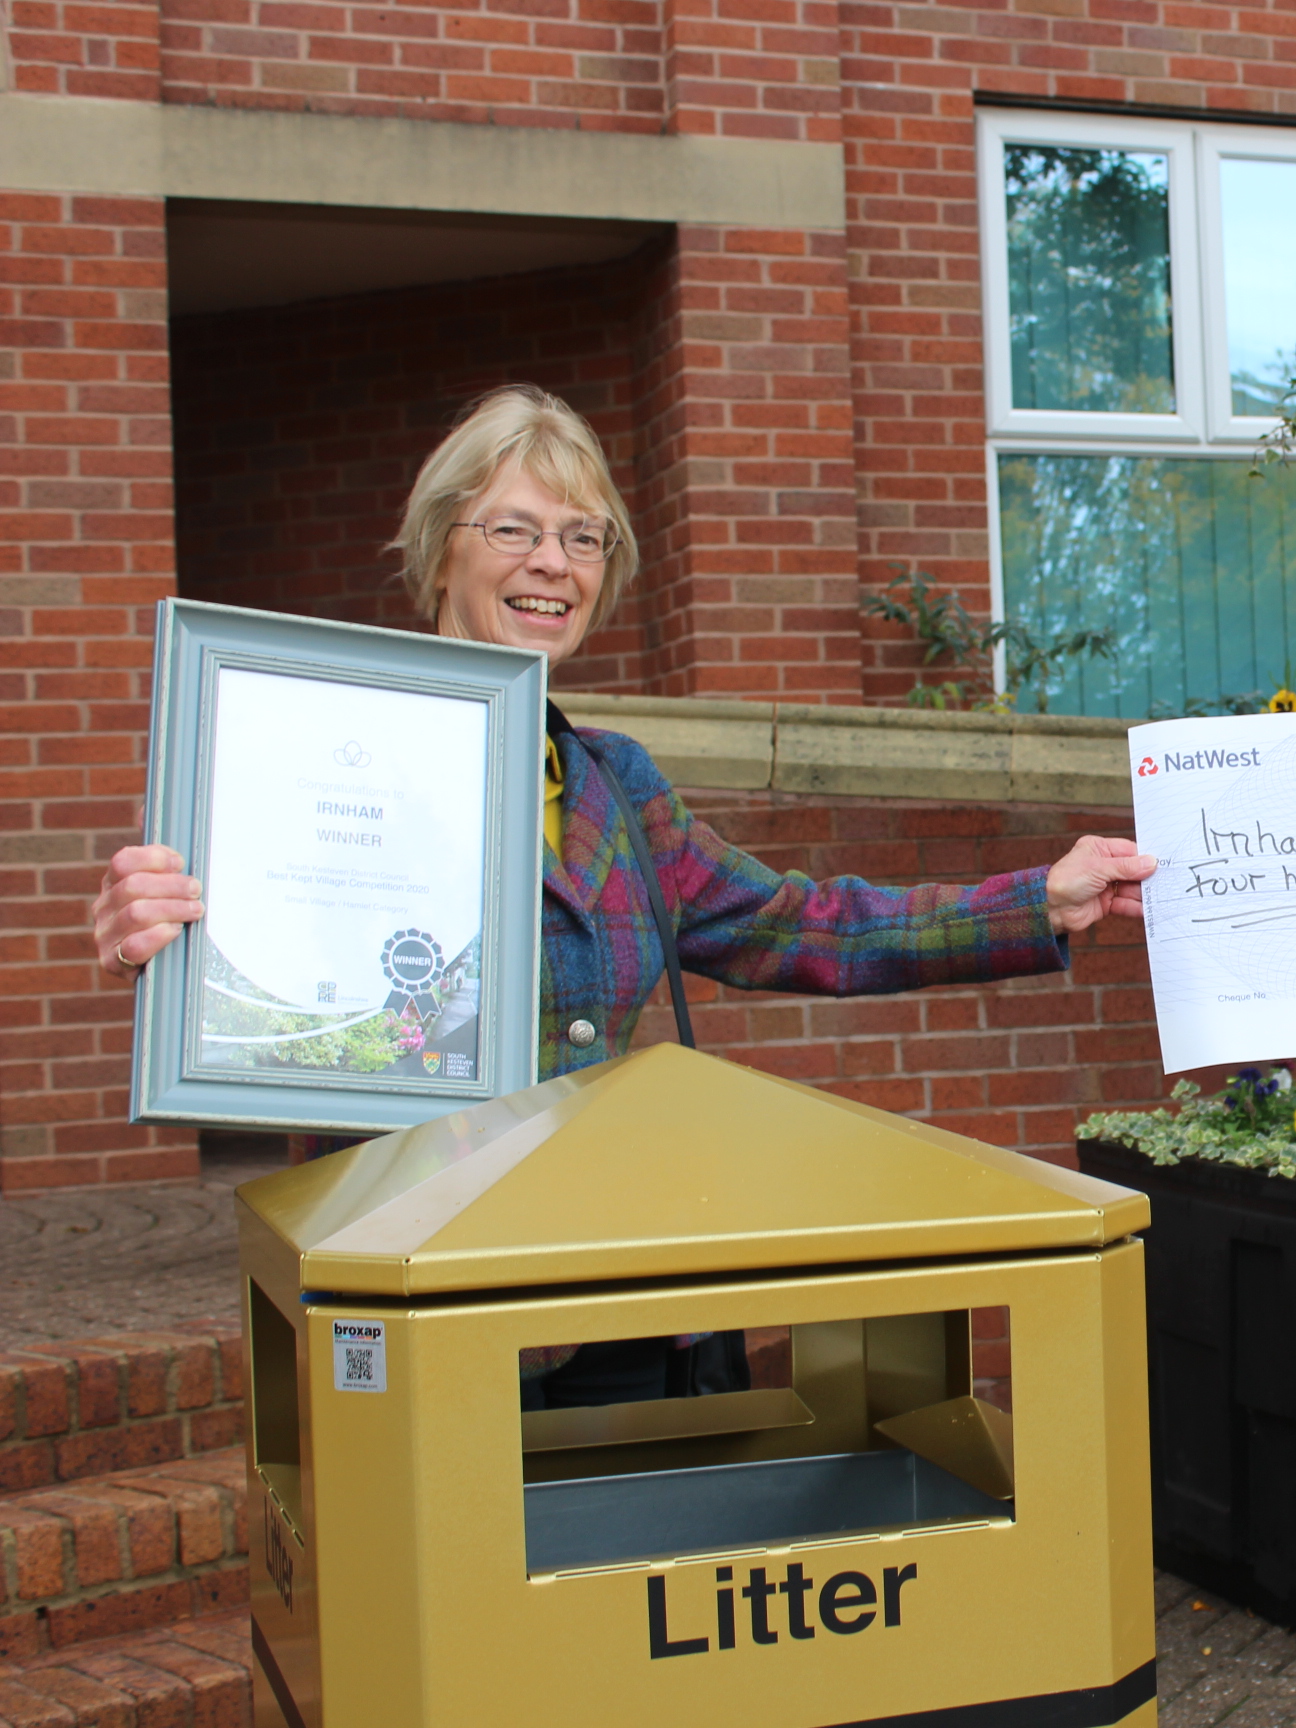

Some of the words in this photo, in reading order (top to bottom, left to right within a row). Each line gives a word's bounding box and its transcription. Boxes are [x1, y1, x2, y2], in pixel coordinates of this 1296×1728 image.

[1164, 748, 1261, 773] NatWest
[297, 777, 390, 799] Congratulations
[393, 789, 405, 800] to
[316, 800, 384, 821] IRNHAM
[316, 828, 382, 848] WINNER
[266, 870, 289, 881] Best
[291, 873, 313, 884] Kept
[315, 875, 347, 888] Village
[349, 877, 405, 893] Competition
[406, 884, 430, 895] 2020
[286, 862, 310, 873] South
[312, 864, 349, 877] Kesteven
[351, 868, 379, 879] District
[379, 871, 410, 883] Council
[1185, 858, 1266, 898] Four
[285, 895, 307, 905] Small
[309, 897, 336, 909] Village
[343, 900, 371, 911] Hamlet
[373, 902, 409, 916] Category
[393, 954, 432, 967] WINNER
[1217, 994, 1251, 1003] Cheque
[1253, 991, 1266, 1000] No
[447, 1052, 467, 1060] SOUTH
[447, 1059, 474, 1067] KESTEVEN
[334, 1322, 382, 1340] broxap
[264, 1494, 293, 1616] Litter
[647, 1562, 918, 1660] Litter
